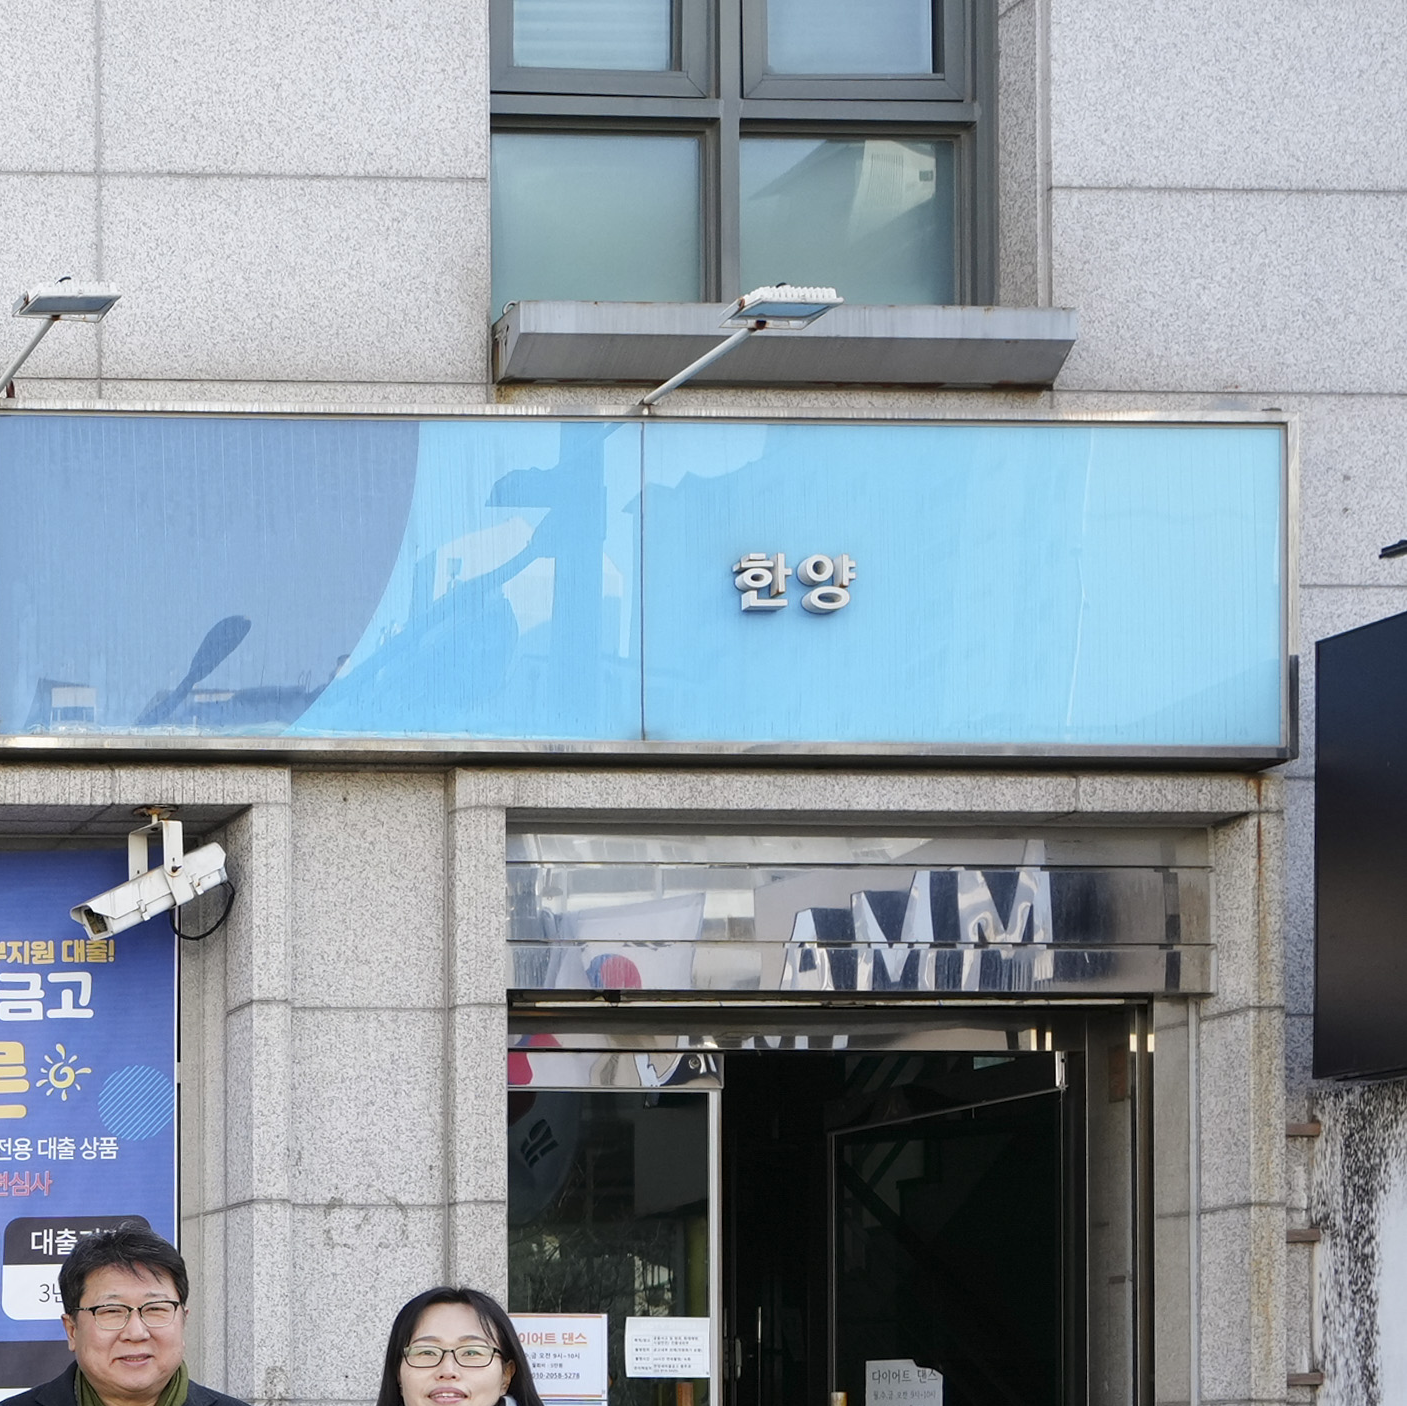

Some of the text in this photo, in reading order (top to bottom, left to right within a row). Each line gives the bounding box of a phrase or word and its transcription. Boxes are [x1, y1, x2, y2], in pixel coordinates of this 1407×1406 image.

[733, 553, 856, 614] 한양
[61, 938, 116, 964] 대출!
[37, 1137, 76, 1161] 대출
[79, 1136, 119, 1161] 상품
[519, 1333, 588, 1346] 이어트 댄스
[872, 1369, 938, 1384] 다이어트 댄스
